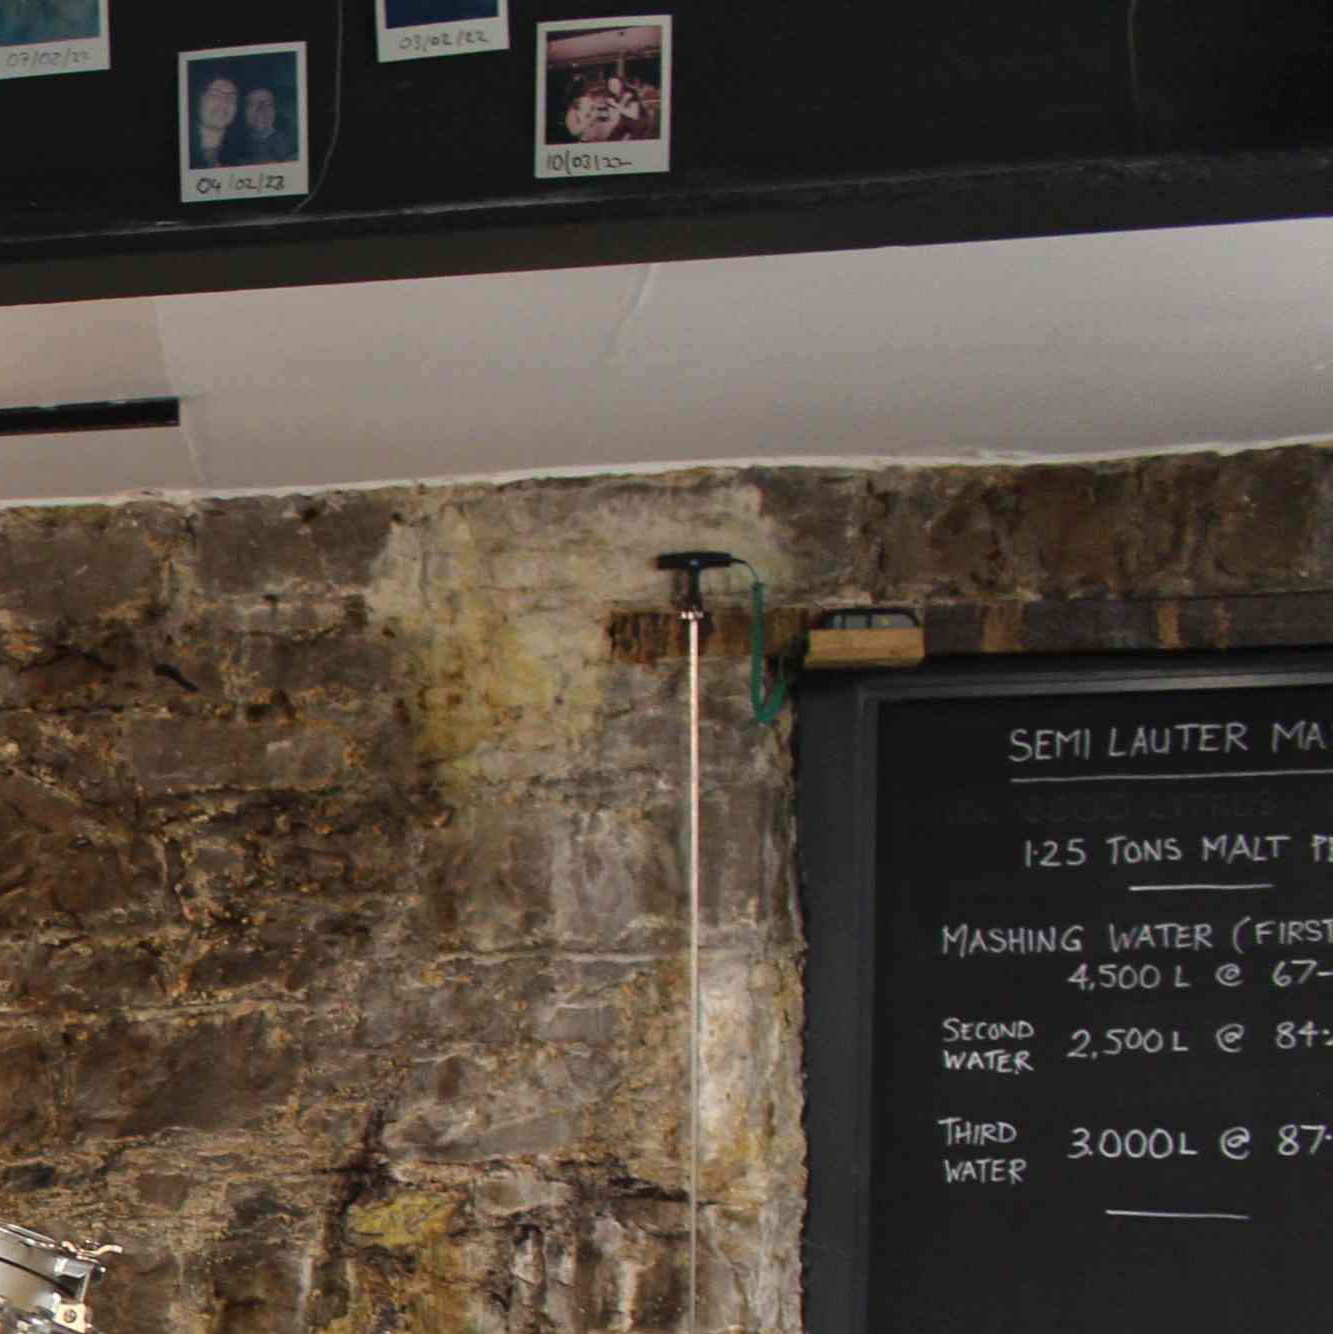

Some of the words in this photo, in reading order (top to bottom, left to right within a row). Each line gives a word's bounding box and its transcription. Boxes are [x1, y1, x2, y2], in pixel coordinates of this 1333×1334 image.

[1008, 728, 1091, 762] SEMI
[1108, 722, 1248, 757] LAUTER
[1105, 835, 1182, 866] TONS
[1201, 834, 1291, 863] MALT
[941, 922, 1084, 958] MASHING
[1109, 923, 1213, 954] WATER
[941, 1018, 1035, 1043] SECOND
[942, 1050, 1034, 1074] WATER
[938, 1118, 1017, 1146] THIRD
[943, 1158, 1027, 1184] WATER
